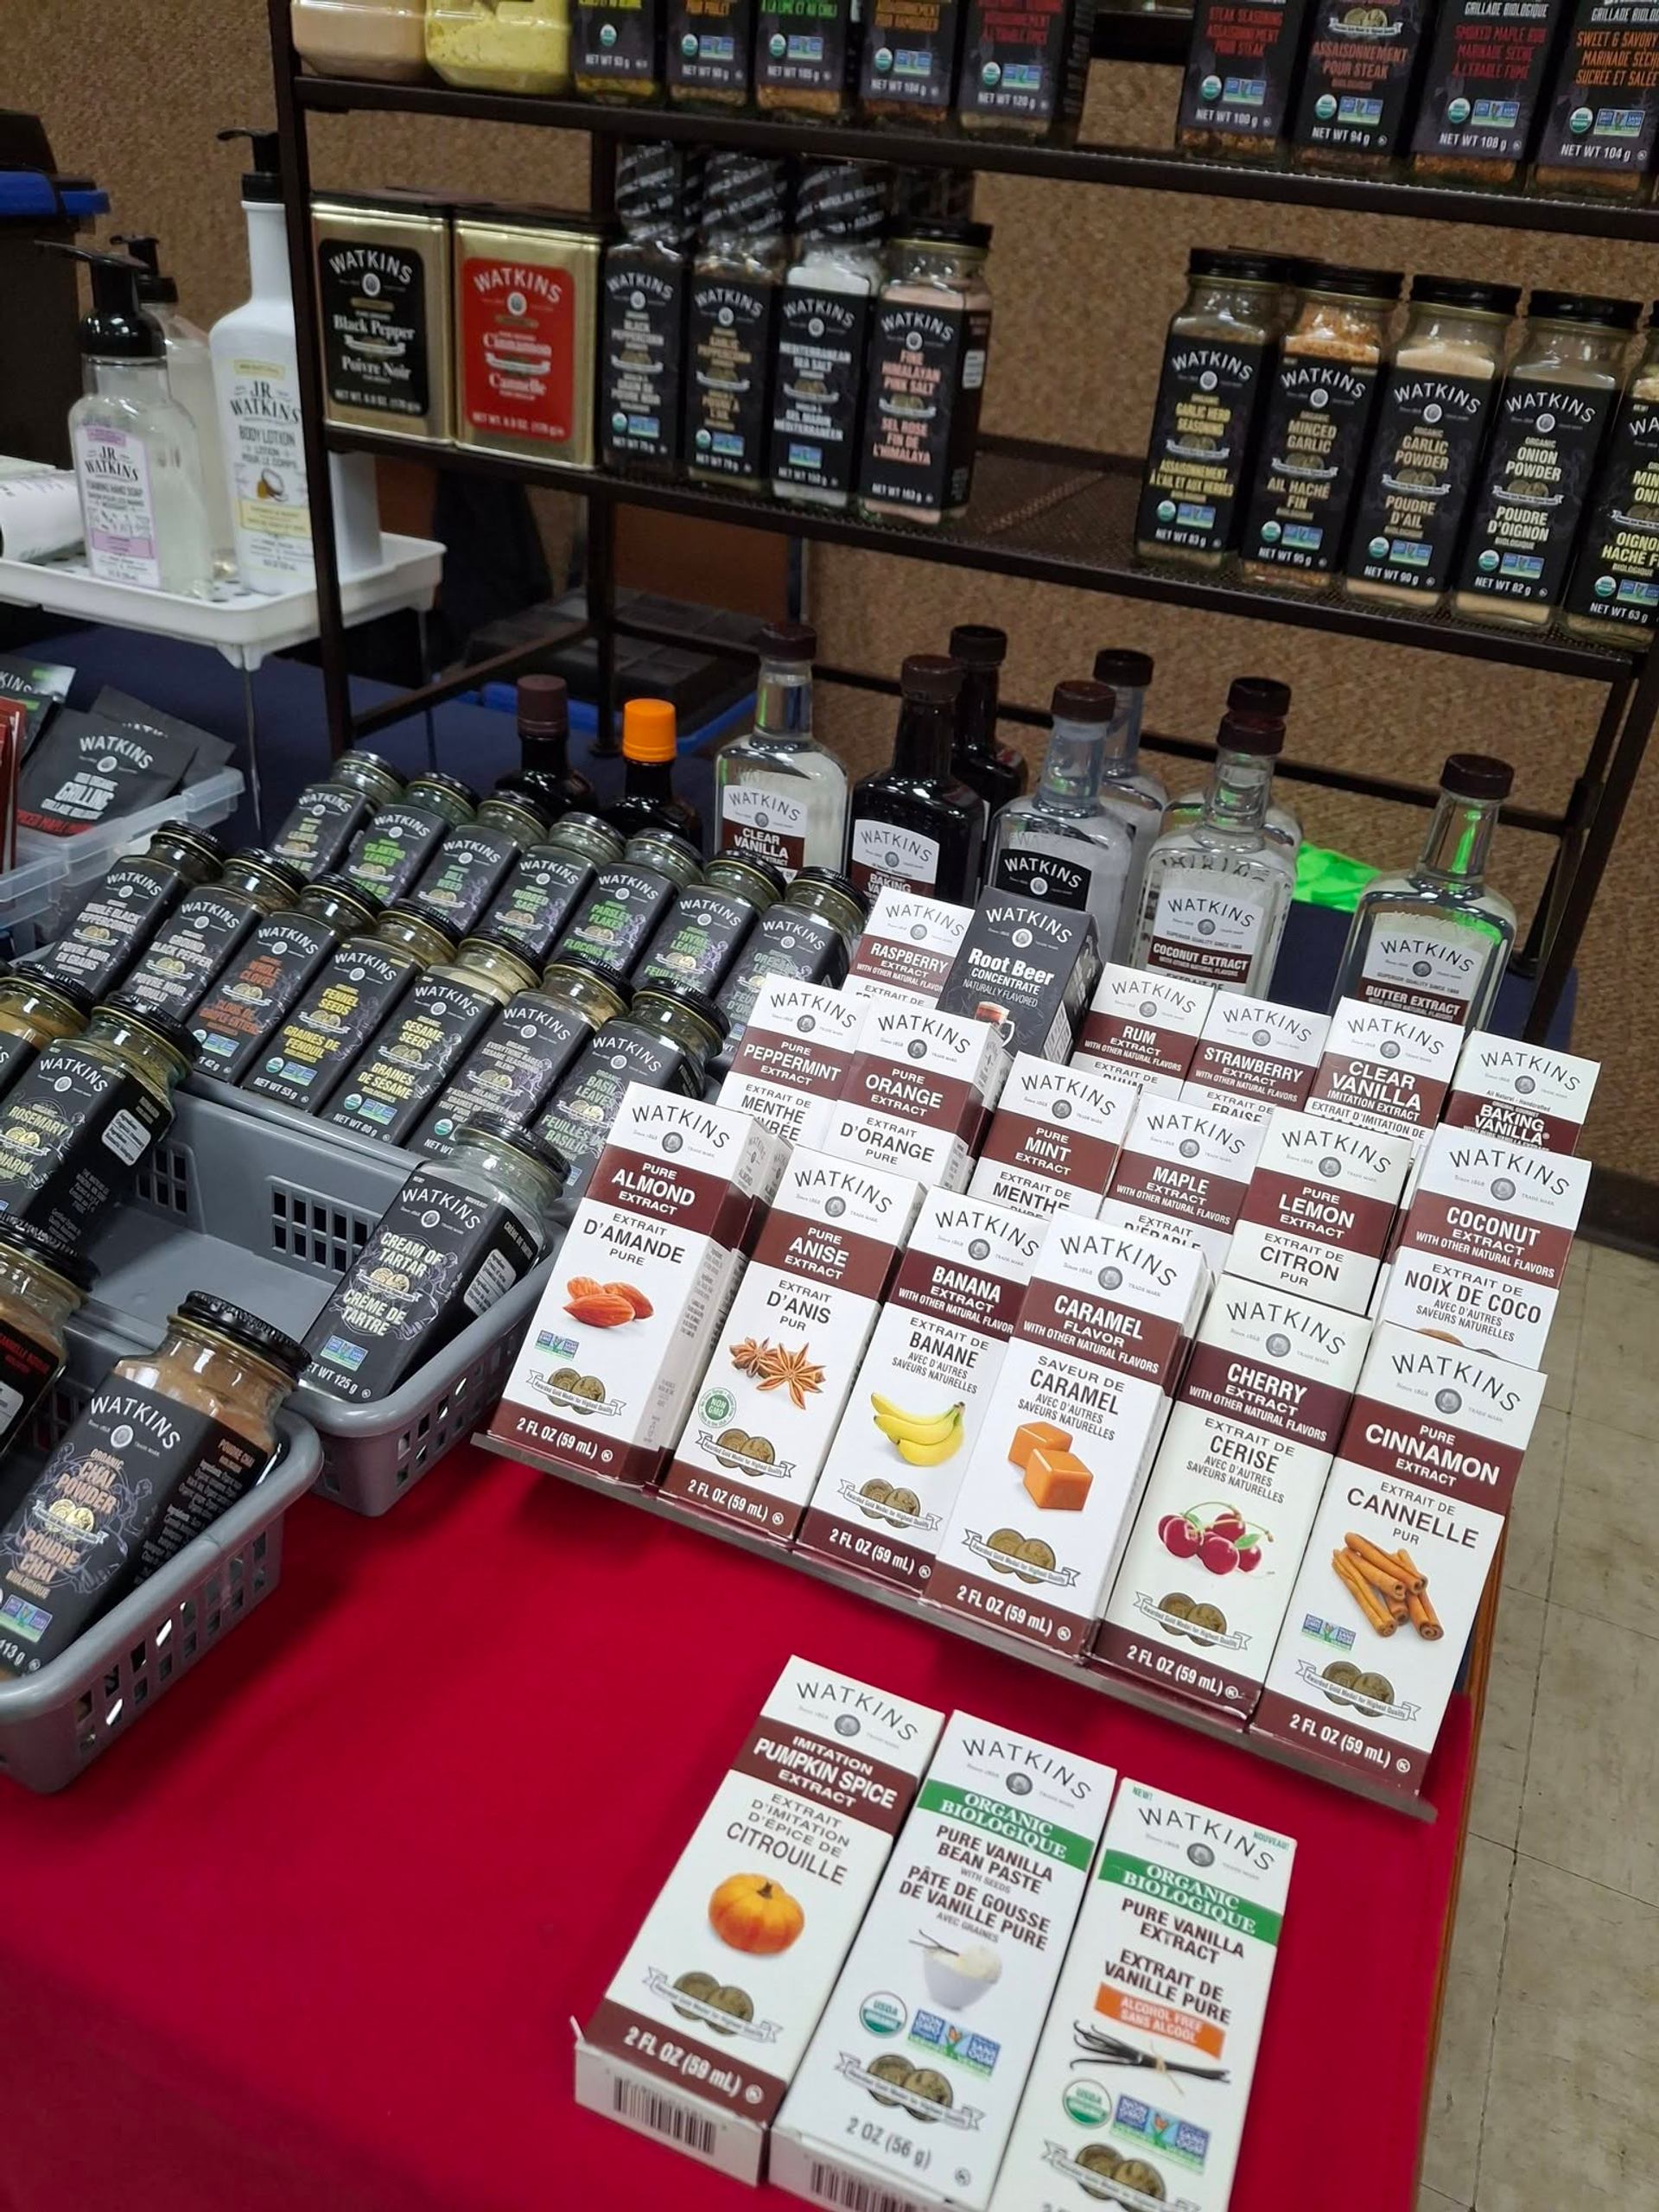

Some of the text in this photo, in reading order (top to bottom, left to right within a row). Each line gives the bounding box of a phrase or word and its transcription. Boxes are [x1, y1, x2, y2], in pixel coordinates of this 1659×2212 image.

[1560, 143, 1631, 162] NET WT 104 g
[329, 250, 413, 285] WATKINS
[474, 268, 563, 303] WATKINS
[334, 314, 368, 334] Black
[371, 320, 416, 341] Pepper
[1173, 351, 1253, 381] WATKINS
[230, 398, 302, 425] WATKINS
[1506, 391, 1596, 423] WATKINS
[1287, 420, 1338, 439] MINCED
[1287, 435, 1332, 454] GARLIC
[1402, 435, 1449, 454] GARLIC
[1395, 450, 1449, 471] POWDER
[1505, 461, 1561, 482] POWDER
[1517, 447, 1558, 465] ONION
[1487, 520, 1549, 542] D'OIGNON
[1496, 505, 1548, 526] POUDRE
[1475, 575, 1532, 596] NET WT 82 g
[79, 735, 154, 770] WATKINS
[729, 791, 800, 821] WATKINS
[734, 836, 789, 859] VANILLA
[742, 828, 780, 845] CLEAR
[1004, 856, 1082, 889] WATKINS
[986, 907, 1073, 944] WATKINS
[1167, 898, 1255, 927] WATKINS
[870, 943, 949, 974] RASPBERRY
[968, 948, 1054, 985] Root Beer
[1154, 942, 1248, 971] COCONUT EXTRACT
[1381, 940, 1475, 972] WATKINS
[963, 979, 1038, 1008] NATURALLY FLAVORED
[970, 967, 1040, 995] CONCENTRATE
[318, 998, 352, 1016] SEEDS
[771, 993, 856, 1028] WATKINS
[1365, 985, 1461, 1016] BUTTER EXTRACT
[398, 1031, 432, 1050] SEEDS
[402, 1020, 445, 1042] SESAME
[1123, 1025, 1157, 1045] RUM
[1347, 1018, 1445, 1055] WATKINS
[593, 1037, 662, 1072] WATKINS
[744, 1044, 841, 1081] PEPPERMINT
[1204, 1047, 1305, 1083] STRAWBERRY
[38, 1058, 109, 1092] WATKINS
[866, 1074, 944, 1109] ORANGE
[1331, 1073, 1421, 1111] VANILLA
[1349, 1060, 1415, 1090] CLEAR
[8, 1105, 68, 1136] ROSEMARY
[741, 1095, 805, 1124] MENTHE
[1327, 1090, 1421, 1121] IMITATION EXTRACT
[1479, 1103, 1546, 1132] BAKING
[632, 1104, 730, 1148] WATKINS
[840, 1122, 935, 1163] D'ORANGE
[1025, 1137, 1071, 1161] MINT
[612, 1169, 696, 1206] ALMOND
[642, 1162, 678, 1179] PURE
[1153, 1166, 1210, 1194] MAPLE
[618, 1191, 677, 1216] EXTRACT
[794, 1169, 893, 1213] WATKINS
[402, 1188, 480, 1230] WATKINS
[1279, 1193, 1355, 1228] LEMON
[1446, 1206, 1541, 1246] COCONUT
[380, 1231, 444, 1265] CREAM OF
[583, 1218, 685, 1264] D'AMANDE
[807, 1227, 842, 1244] PURE
[935, 1211, 1039, 1256] WATKINS
[378, 1248, 429, 1278] TARTAR
[789, 1236, 849, 1268] ANISE
[1060, 1236, 1177, 1287] WATKINS
[1260, 1246, 1340, 1281] CITRON
[931, 1266, 1001, 1302] BANANA
[1404, 1270, 1541, 1324] NOIX DE COCO
[341, 1306, 391, 1337] TARTRE
[390, 1306, 408, 1325] DE
[766, 1290, 831, 1325] D'ANIS
[899, 1288, 918, 1302] WITH
[919, 1295, 945, 1311] OTHER
[945, 1303, 981, 1324] NATURAL
[1054, 1294, 1144, 1339] CARAMEL
[909, 1332, 979, 1369] BANANE
[1064, 1320, 1125, 1347] FLAVOR
[1227, 1363, 1308, 1403] CHERRY
[1392, 1354, 1521, 1411] WATKINS
[91, 1395, 181, 1450] WATKINS
[516, 1417, 598, 1459] 2 FL OZ (59 mL)
[90, 1448, 124, 1470] ORGANIC
[1210, 1435, 1280, 1473] CERISE
[1365, 1424, 1500, 1485] CINNAMON
[55, 1472, 118, 1514] POWDER
[79, 1461, 117, 1491] CHAI
[1347, 1488, 1479, 1549] CANNELLE
[1393, 1528, 1420, 1544] PUR
[797, 1682, 918, 1740] WATKINS
[753, 1738, 897, 1808] PUMPKIN SPICE
[792, 1736, 873, 1775] IMITATION
[963, 1739, 1091, 1799] WATKINS
[778, 1771, 855, 1807] EXTRACT
[939, 1799, 1067, 1859] BIOLOGIQUE
[965, 1793, 1053, 1835] ORGANIC
[727, 1822, 848, 1885] CITROUILLE
[937, 1825, 1052, 1882] PURE VANILLA
[1139, 1808, 1275, 1870] WATKINS
[938, 1843, 1043, 1894] BEAN PASTE
[961, 1867, 1010, 1893] WITH SEEDS
[899, 1880, 1048, 1950] DE VANILLE PURE
[908, 1866, 1051, 1934] PÂTE DE GOUSSE
[1122, 1897, 1244, 1958] PURE VANILLA
[1140, 1922, 1220, 1965] EXTRACT
[1120, 1948, 1224, 2002] EXTRAIT DE
[1104, 1961, 1232, 2025] VANILLE PURE
